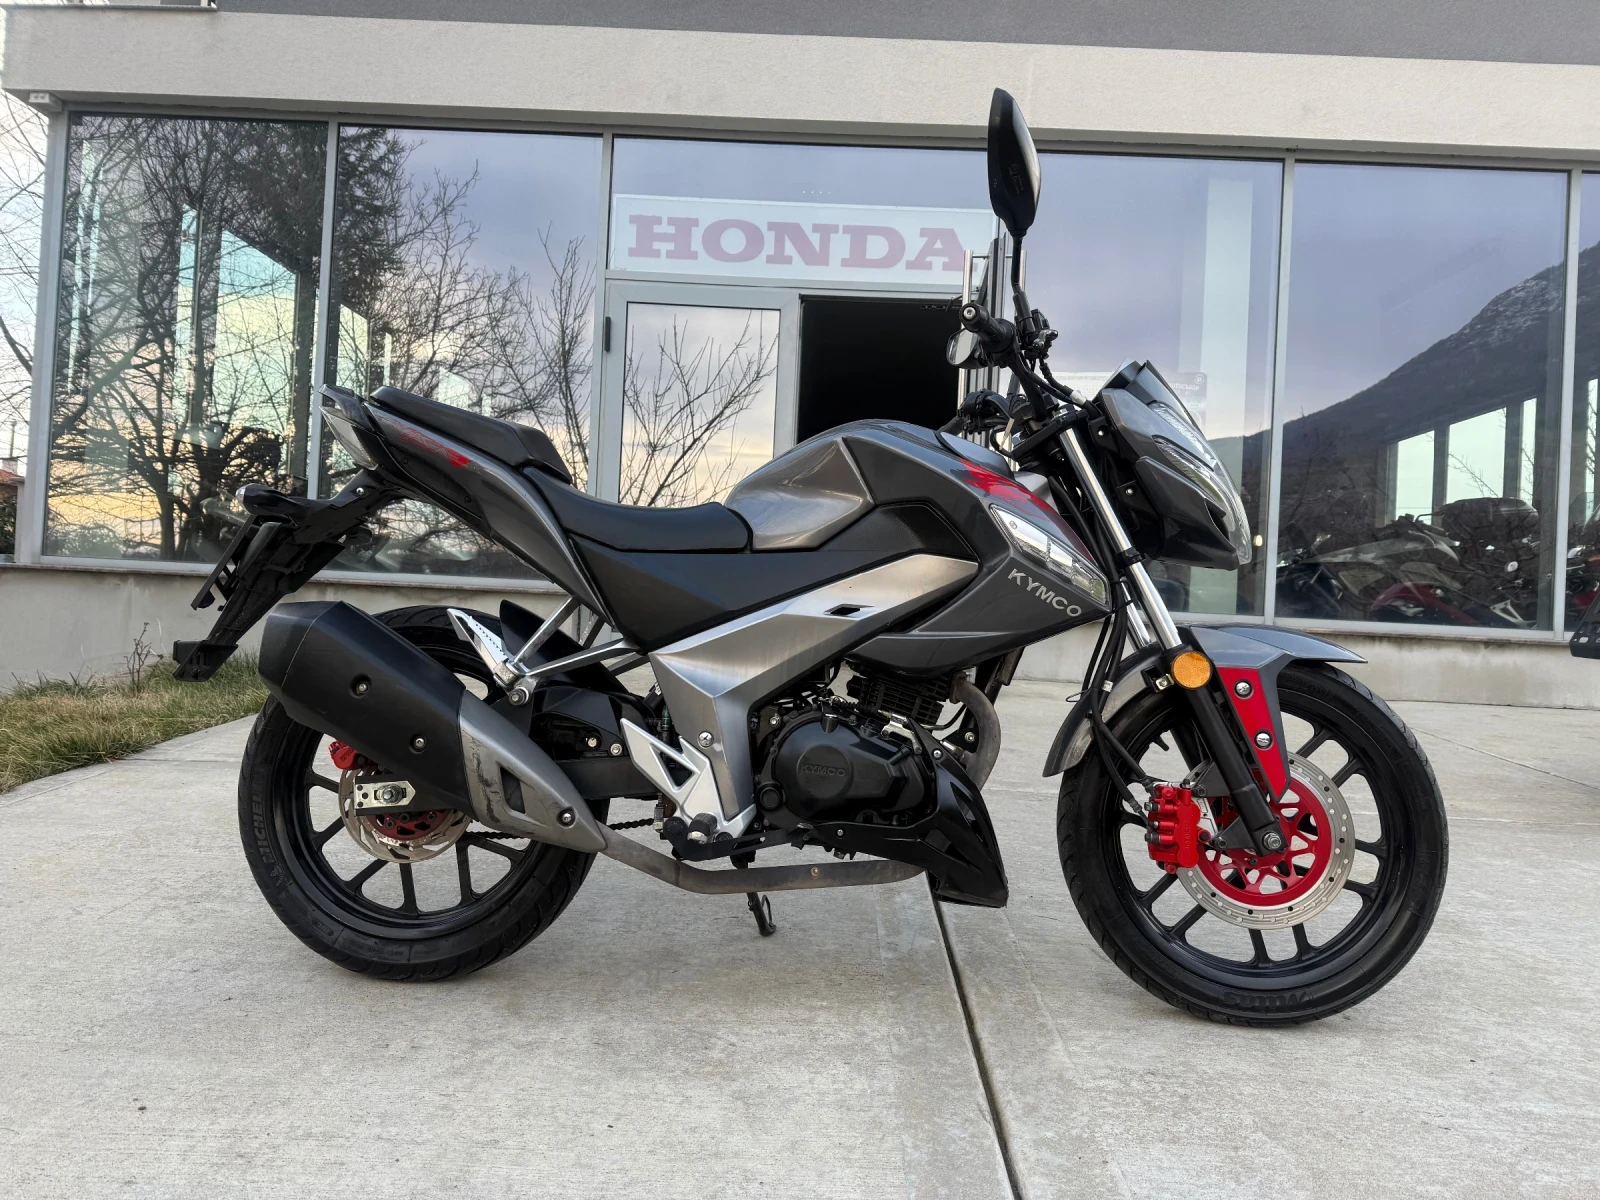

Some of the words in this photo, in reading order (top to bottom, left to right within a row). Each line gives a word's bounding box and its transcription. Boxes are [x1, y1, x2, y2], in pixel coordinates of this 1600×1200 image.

[627, 214, 978, 273] HONDA
[1007, 568, 1082, 617] KYMCO
[800, 763, 846, 777] KYMCO
